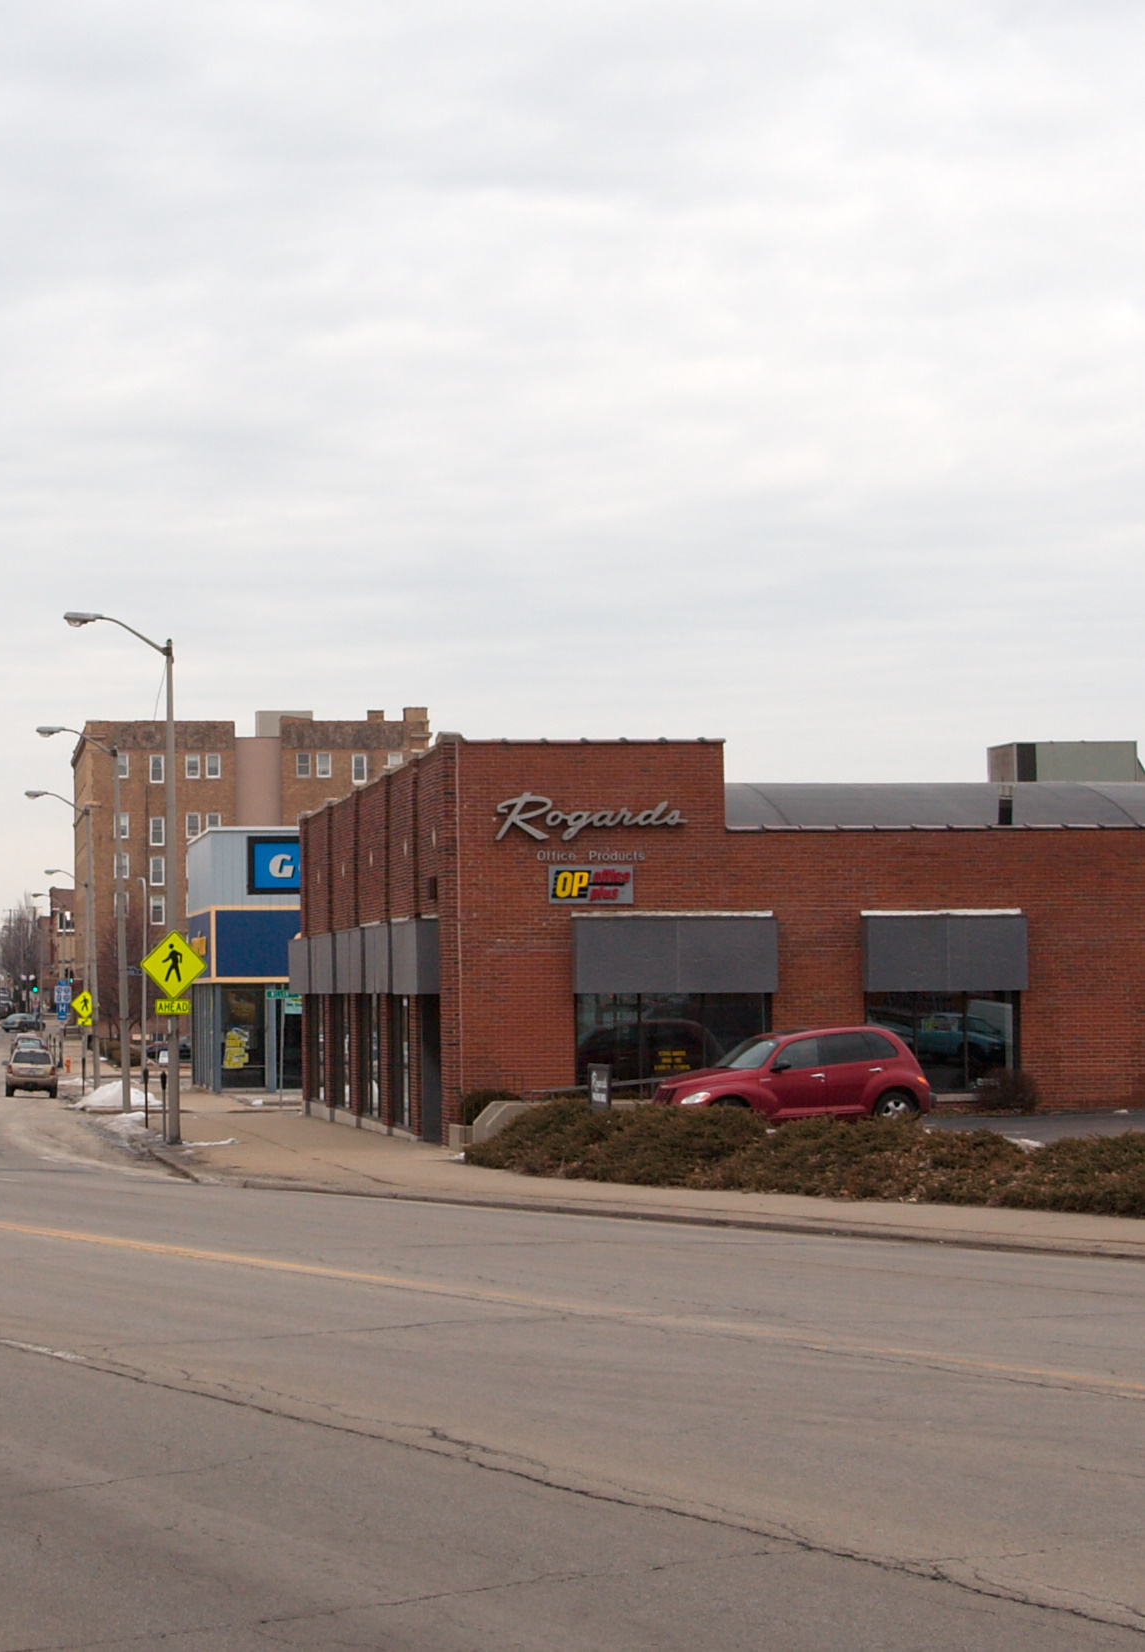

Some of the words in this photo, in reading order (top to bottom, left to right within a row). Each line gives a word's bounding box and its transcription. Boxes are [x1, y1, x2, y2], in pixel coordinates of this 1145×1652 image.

[494, 792, 689, 841] Rogards
[536, 851, 576, 861] Office
[588, 851, 645, 861] Products
[269, 854, 300, 878] G
[592, 869, 631, 883] office
[555, 871, 589, 898] OP
[589, 886, 619, 901] plus
[58, 1003, 66, 1012] H
[158, 1002, 188, 1012] AHEAD
